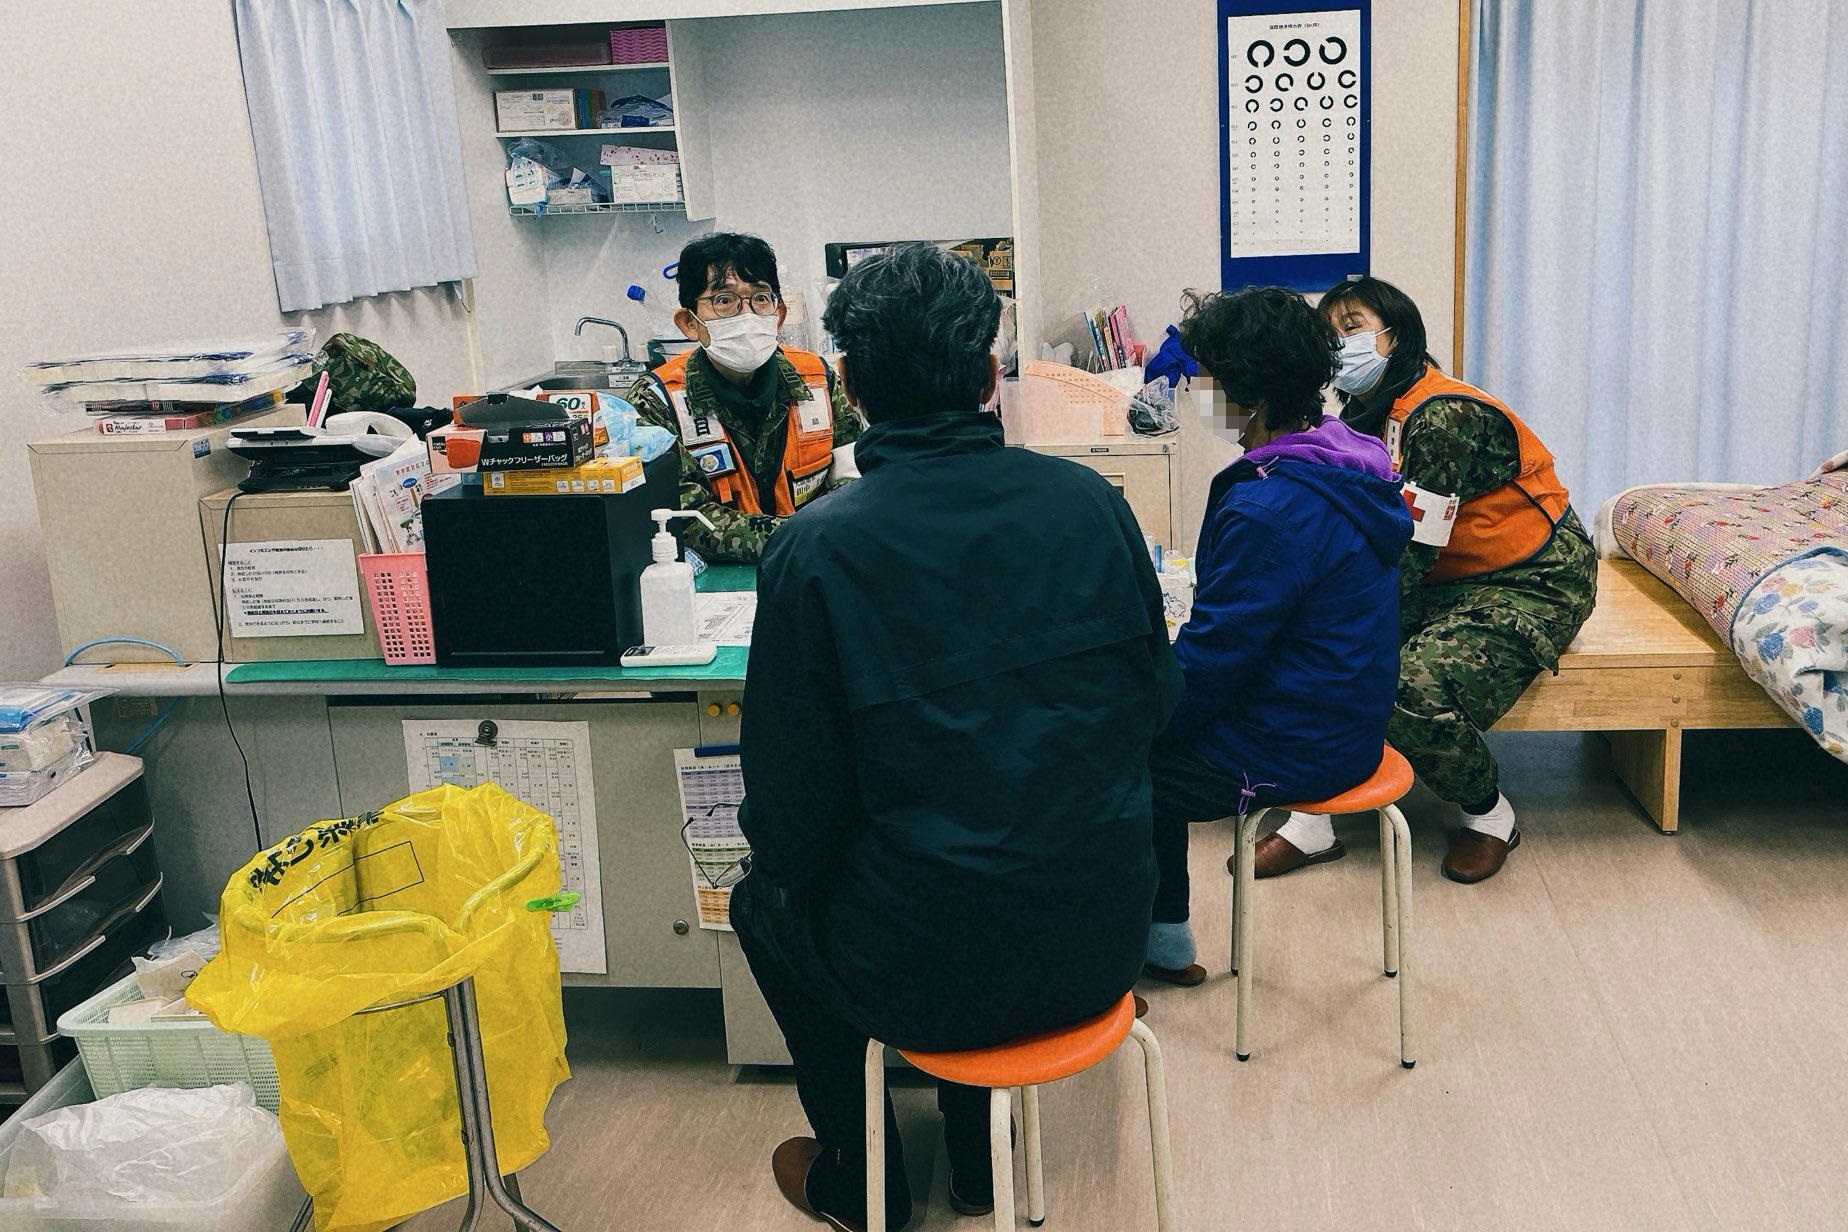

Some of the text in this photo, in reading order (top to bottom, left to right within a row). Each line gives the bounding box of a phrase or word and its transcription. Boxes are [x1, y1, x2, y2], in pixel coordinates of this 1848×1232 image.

[556, 397, 580, 410] 60
[481, 453, 568, 467] Wチャックフリーザーバッグ
